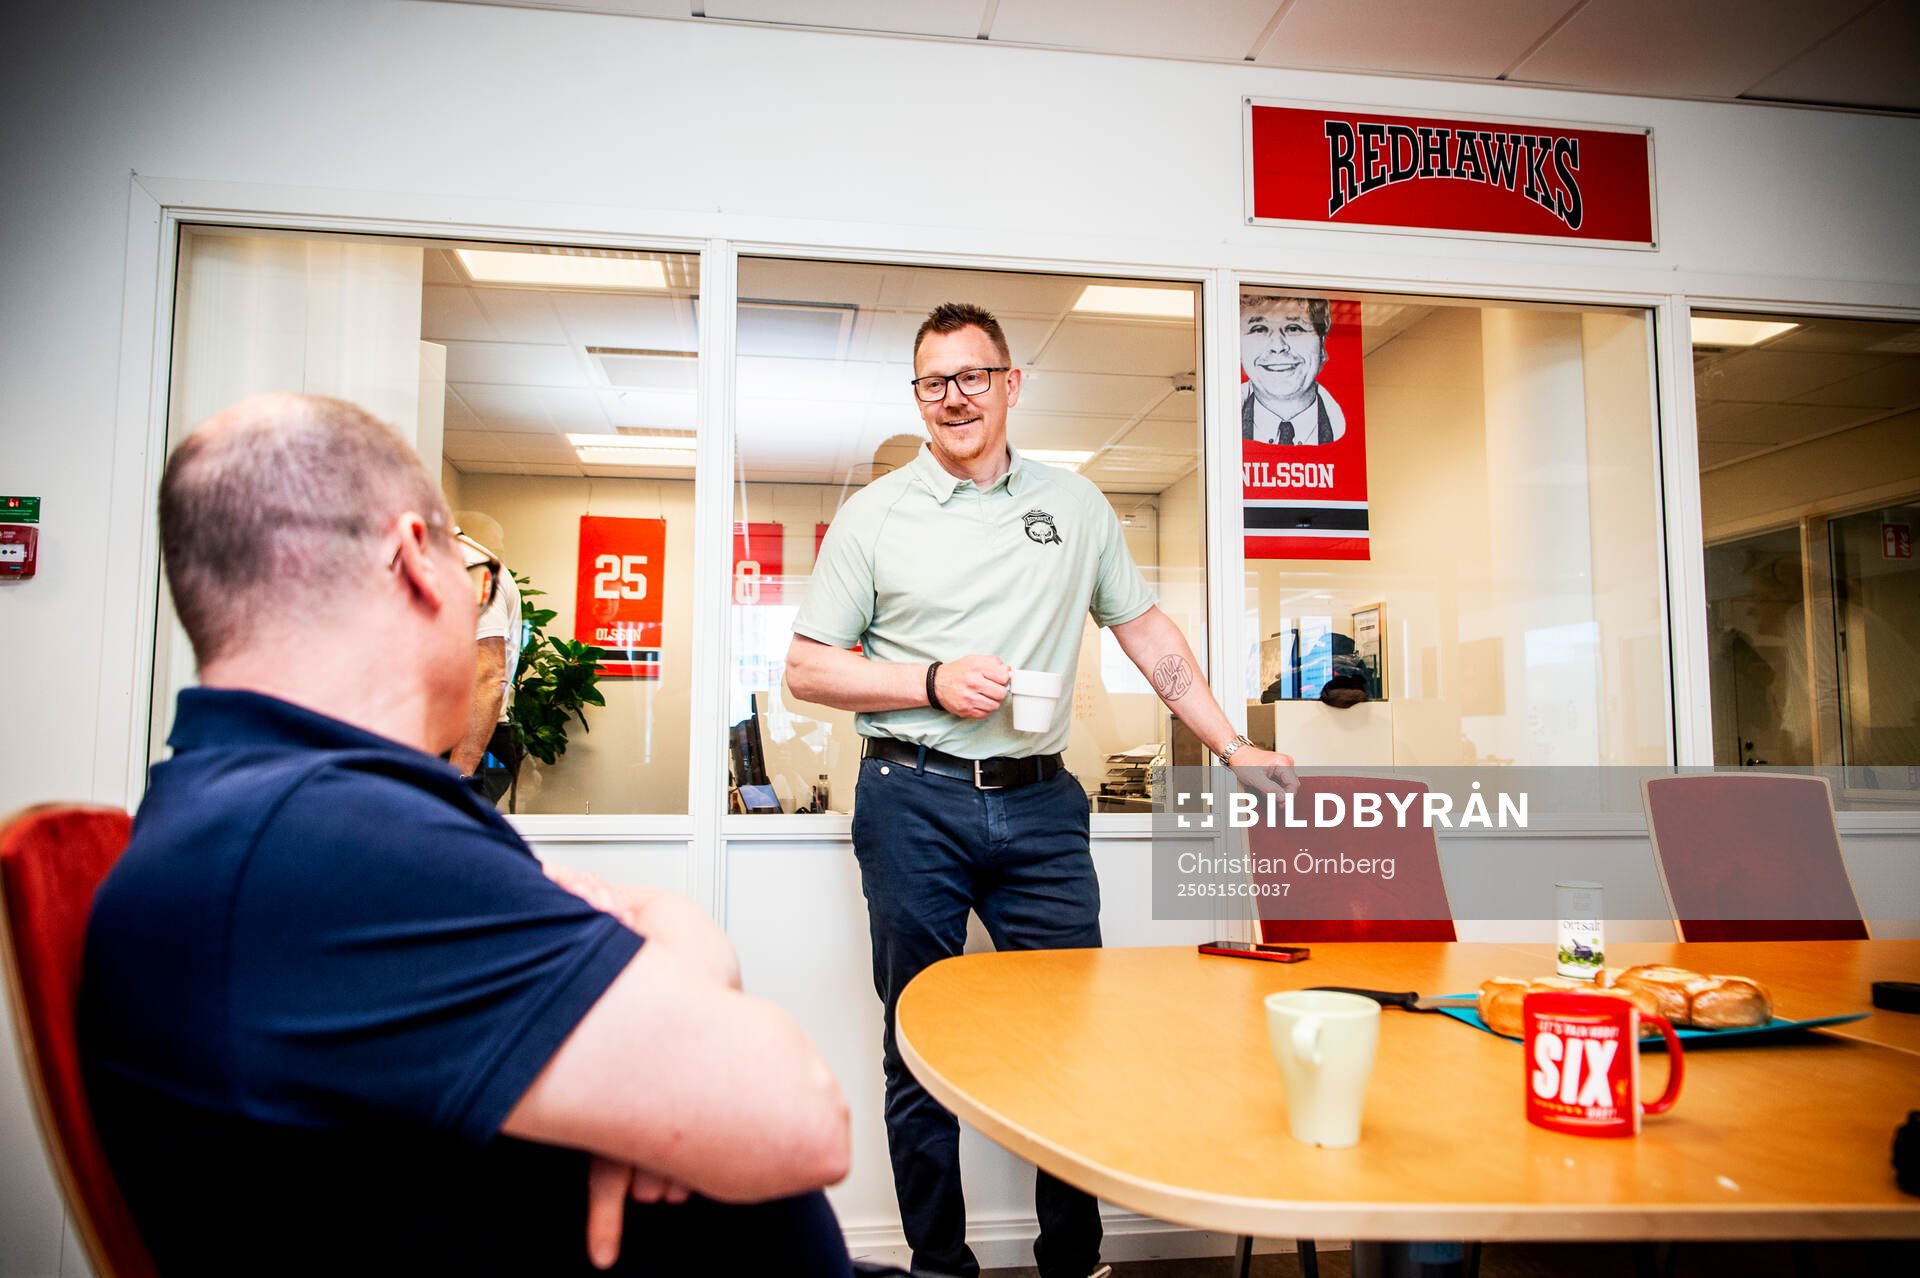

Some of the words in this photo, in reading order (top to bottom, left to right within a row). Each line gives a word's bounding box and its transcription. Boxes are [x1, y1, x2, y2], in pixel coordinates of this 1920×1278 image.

[1324, 120, 1584, 230] REDHAWKS
[1241, 462, 1335, 488] NILSSON
[594, 554, 648, 600] 25
[595, 628, 642, 642] OLSSON
[1532, 1031, 1618, 1107] SIX
